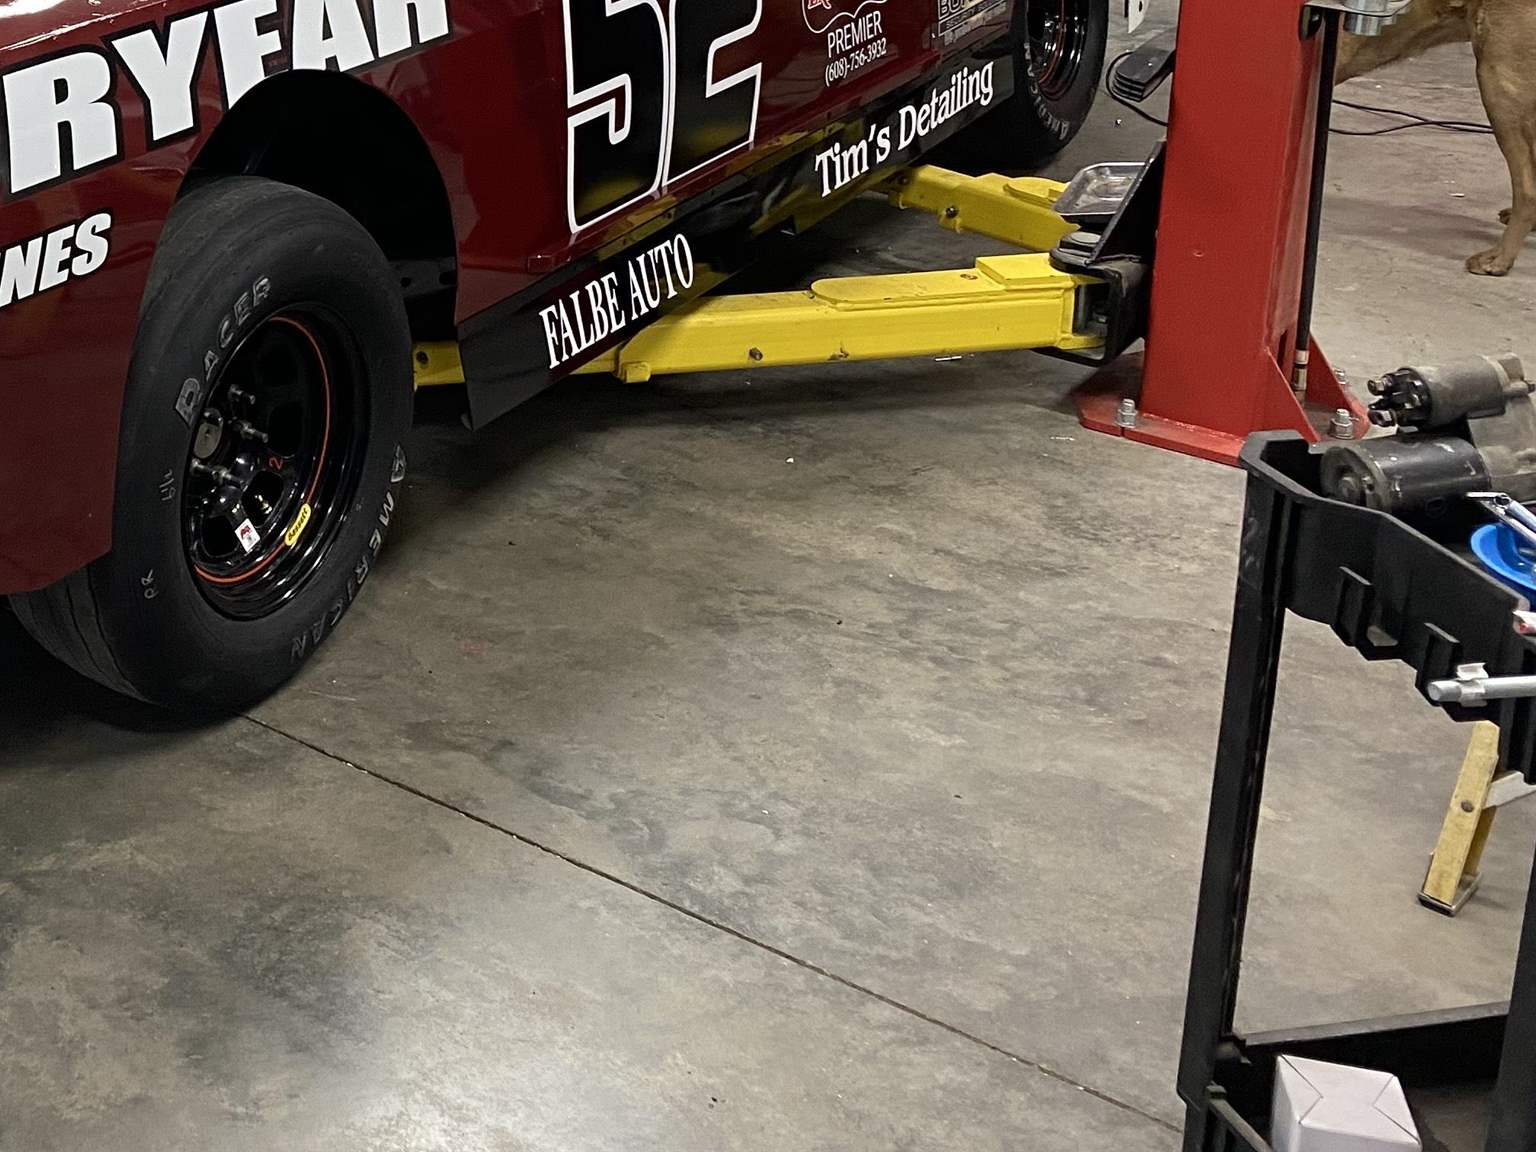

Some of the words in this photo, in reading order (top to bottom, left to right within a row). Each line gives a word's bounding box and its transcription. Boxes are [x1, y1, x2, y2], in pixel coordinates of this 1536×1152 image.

[824, 38, 887, 88] (608)-756-3932
[827, 10, 883, 58] PREMIER
[814, 124, 891, 198] Tim's
[898, 61, 994, 151] Detailing
[175, 277, 272, 429] RACER
[539, 279, 628, 369] FALBE
[624, 233, 695, 320] AUTO
[291, 443, 407, 660] AMERICAN
